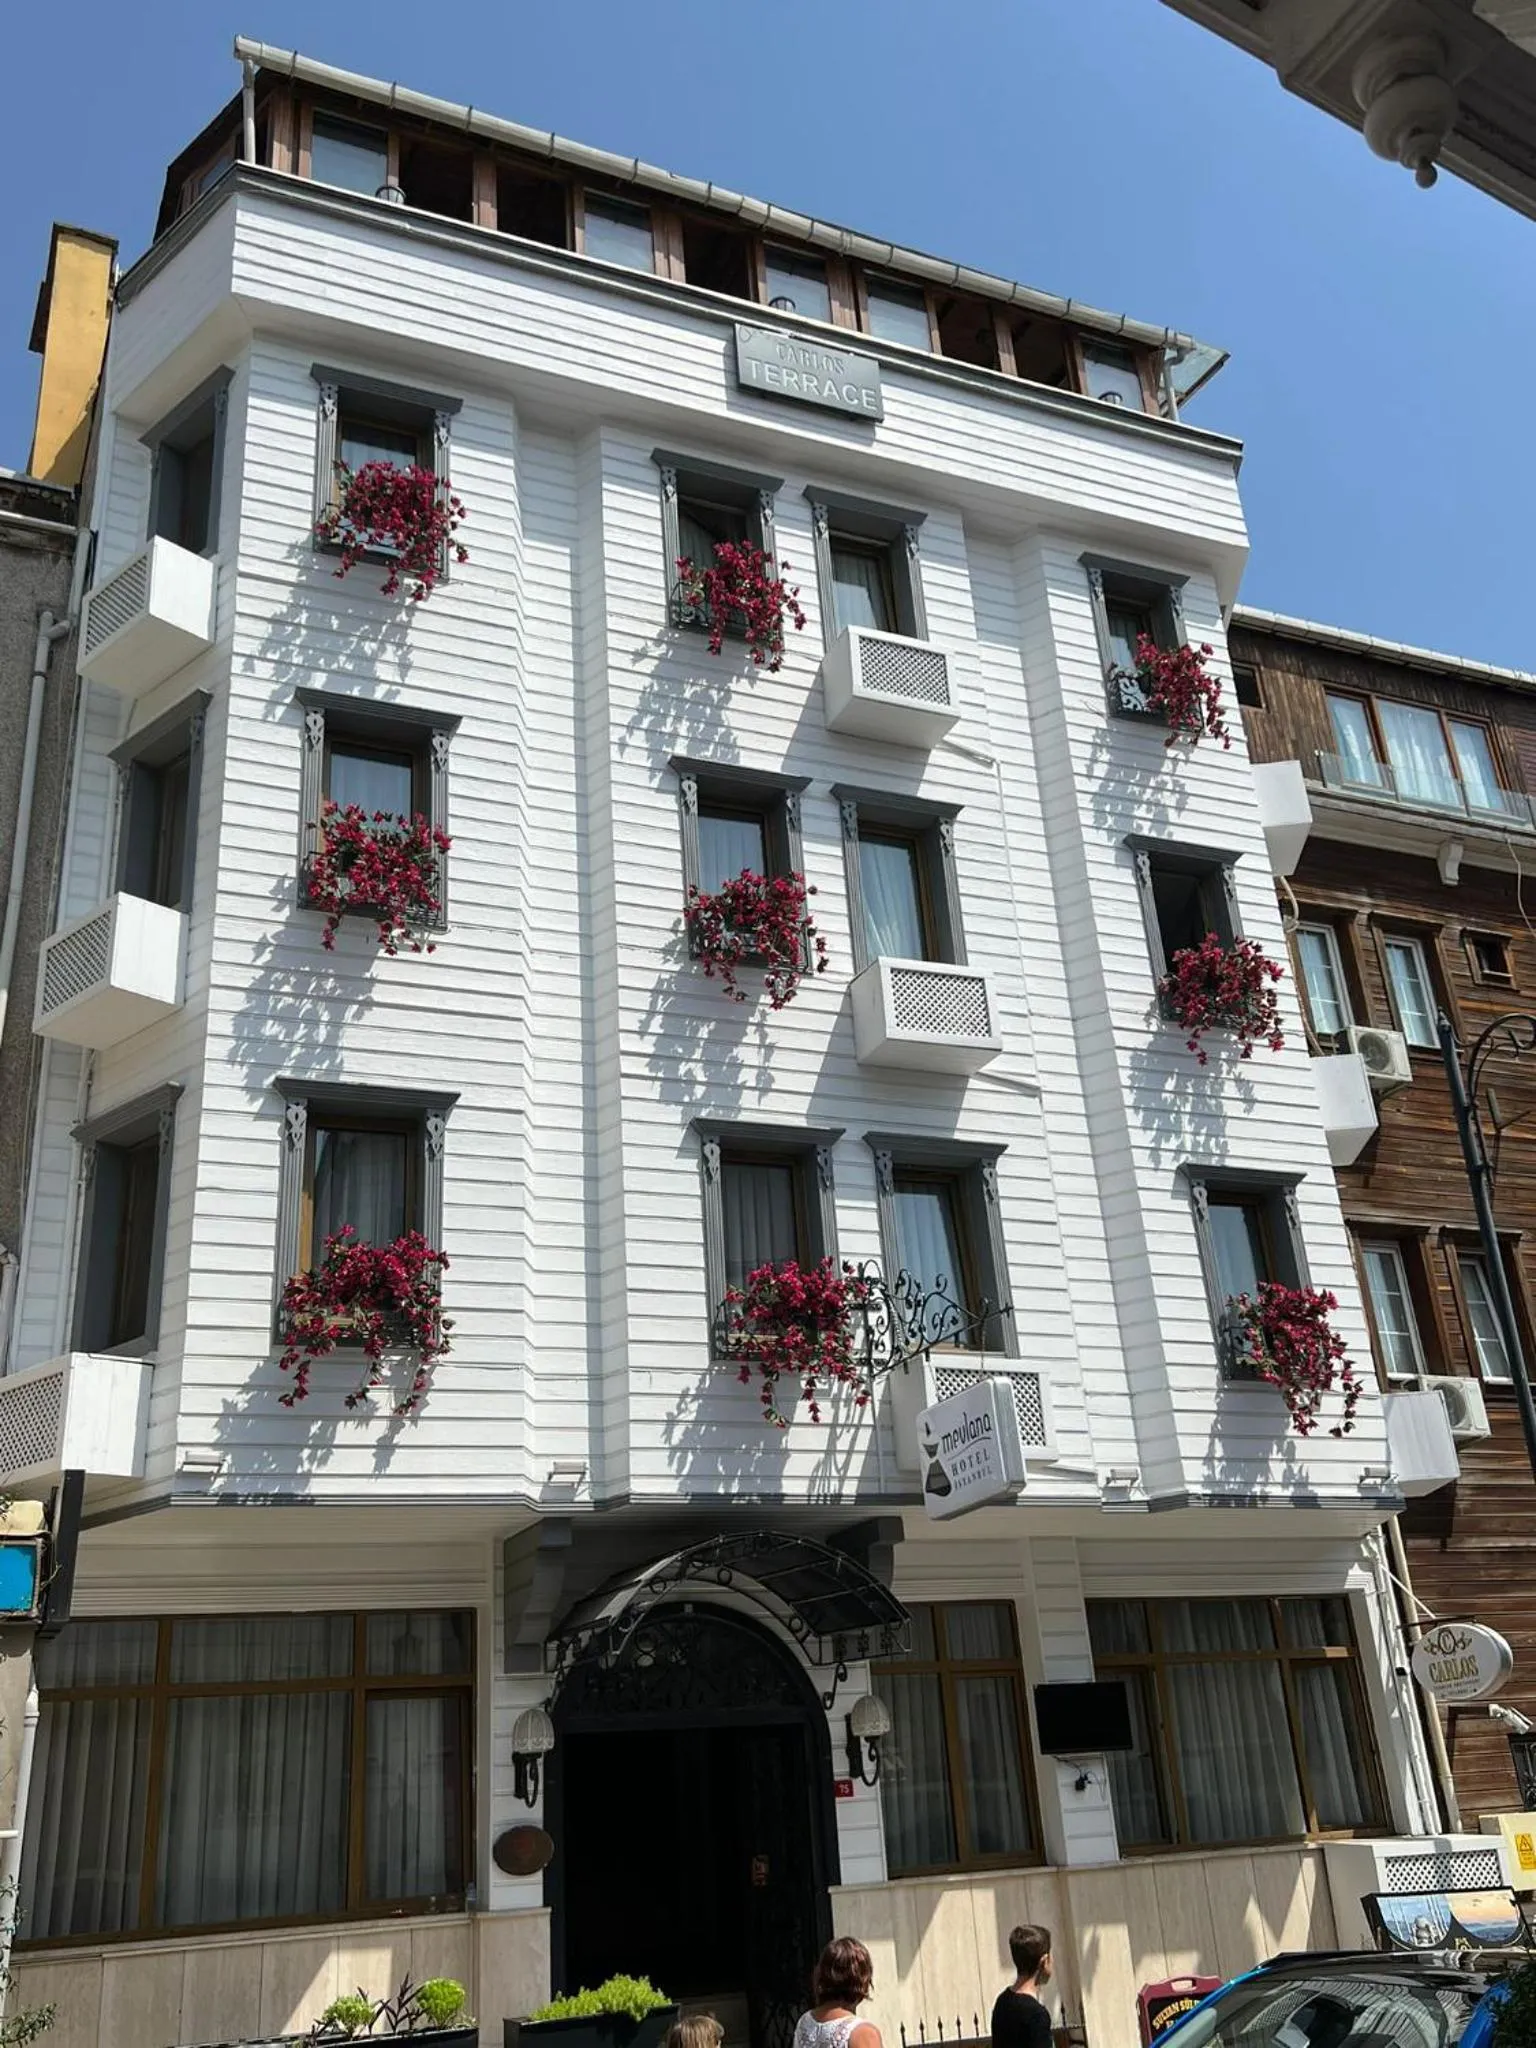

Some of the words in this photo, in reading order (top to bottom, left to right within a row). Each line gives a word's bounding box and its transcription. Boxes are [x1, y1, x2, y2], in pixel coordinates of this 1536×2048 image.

[776, 343, 845, 375] CARLOS
[746, 357, 877, 410] TERRACE
[941, 1411, 992, 1454] mevlana
[951, 1448, 991, 1477] HOTEL
[1428, 1654, 1479, 1683] CARLOS
